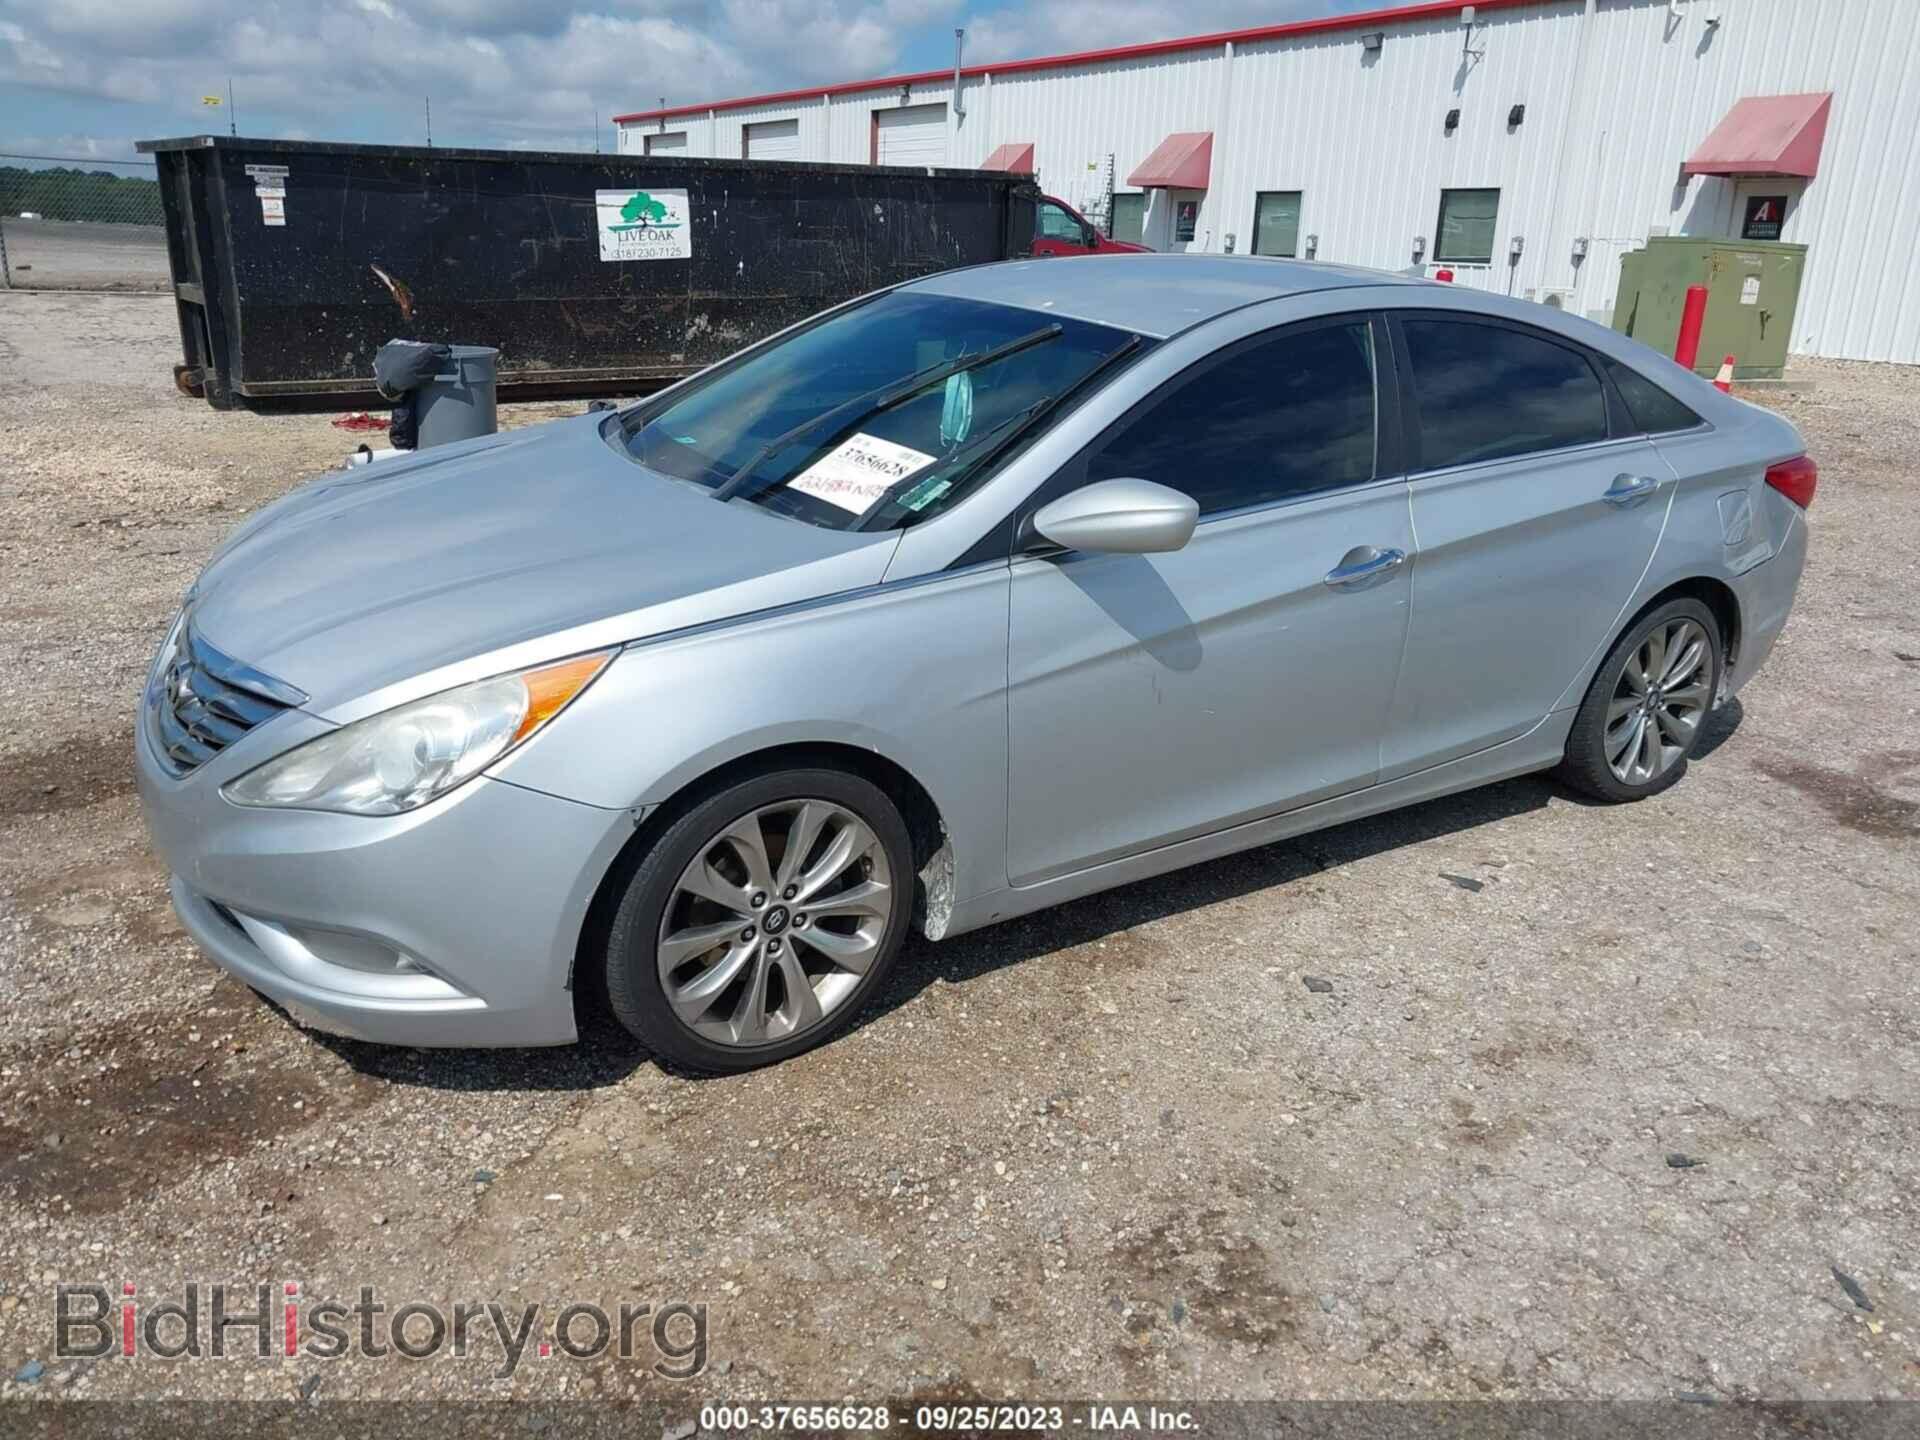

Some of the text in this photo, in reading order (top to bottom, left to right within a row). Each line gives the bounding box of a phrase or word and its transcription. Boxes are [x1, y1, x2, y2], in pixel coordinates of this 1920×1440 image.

[618, 229, 675, 241] LIVE OAK
[838, 447, 909, 477] 37656628
